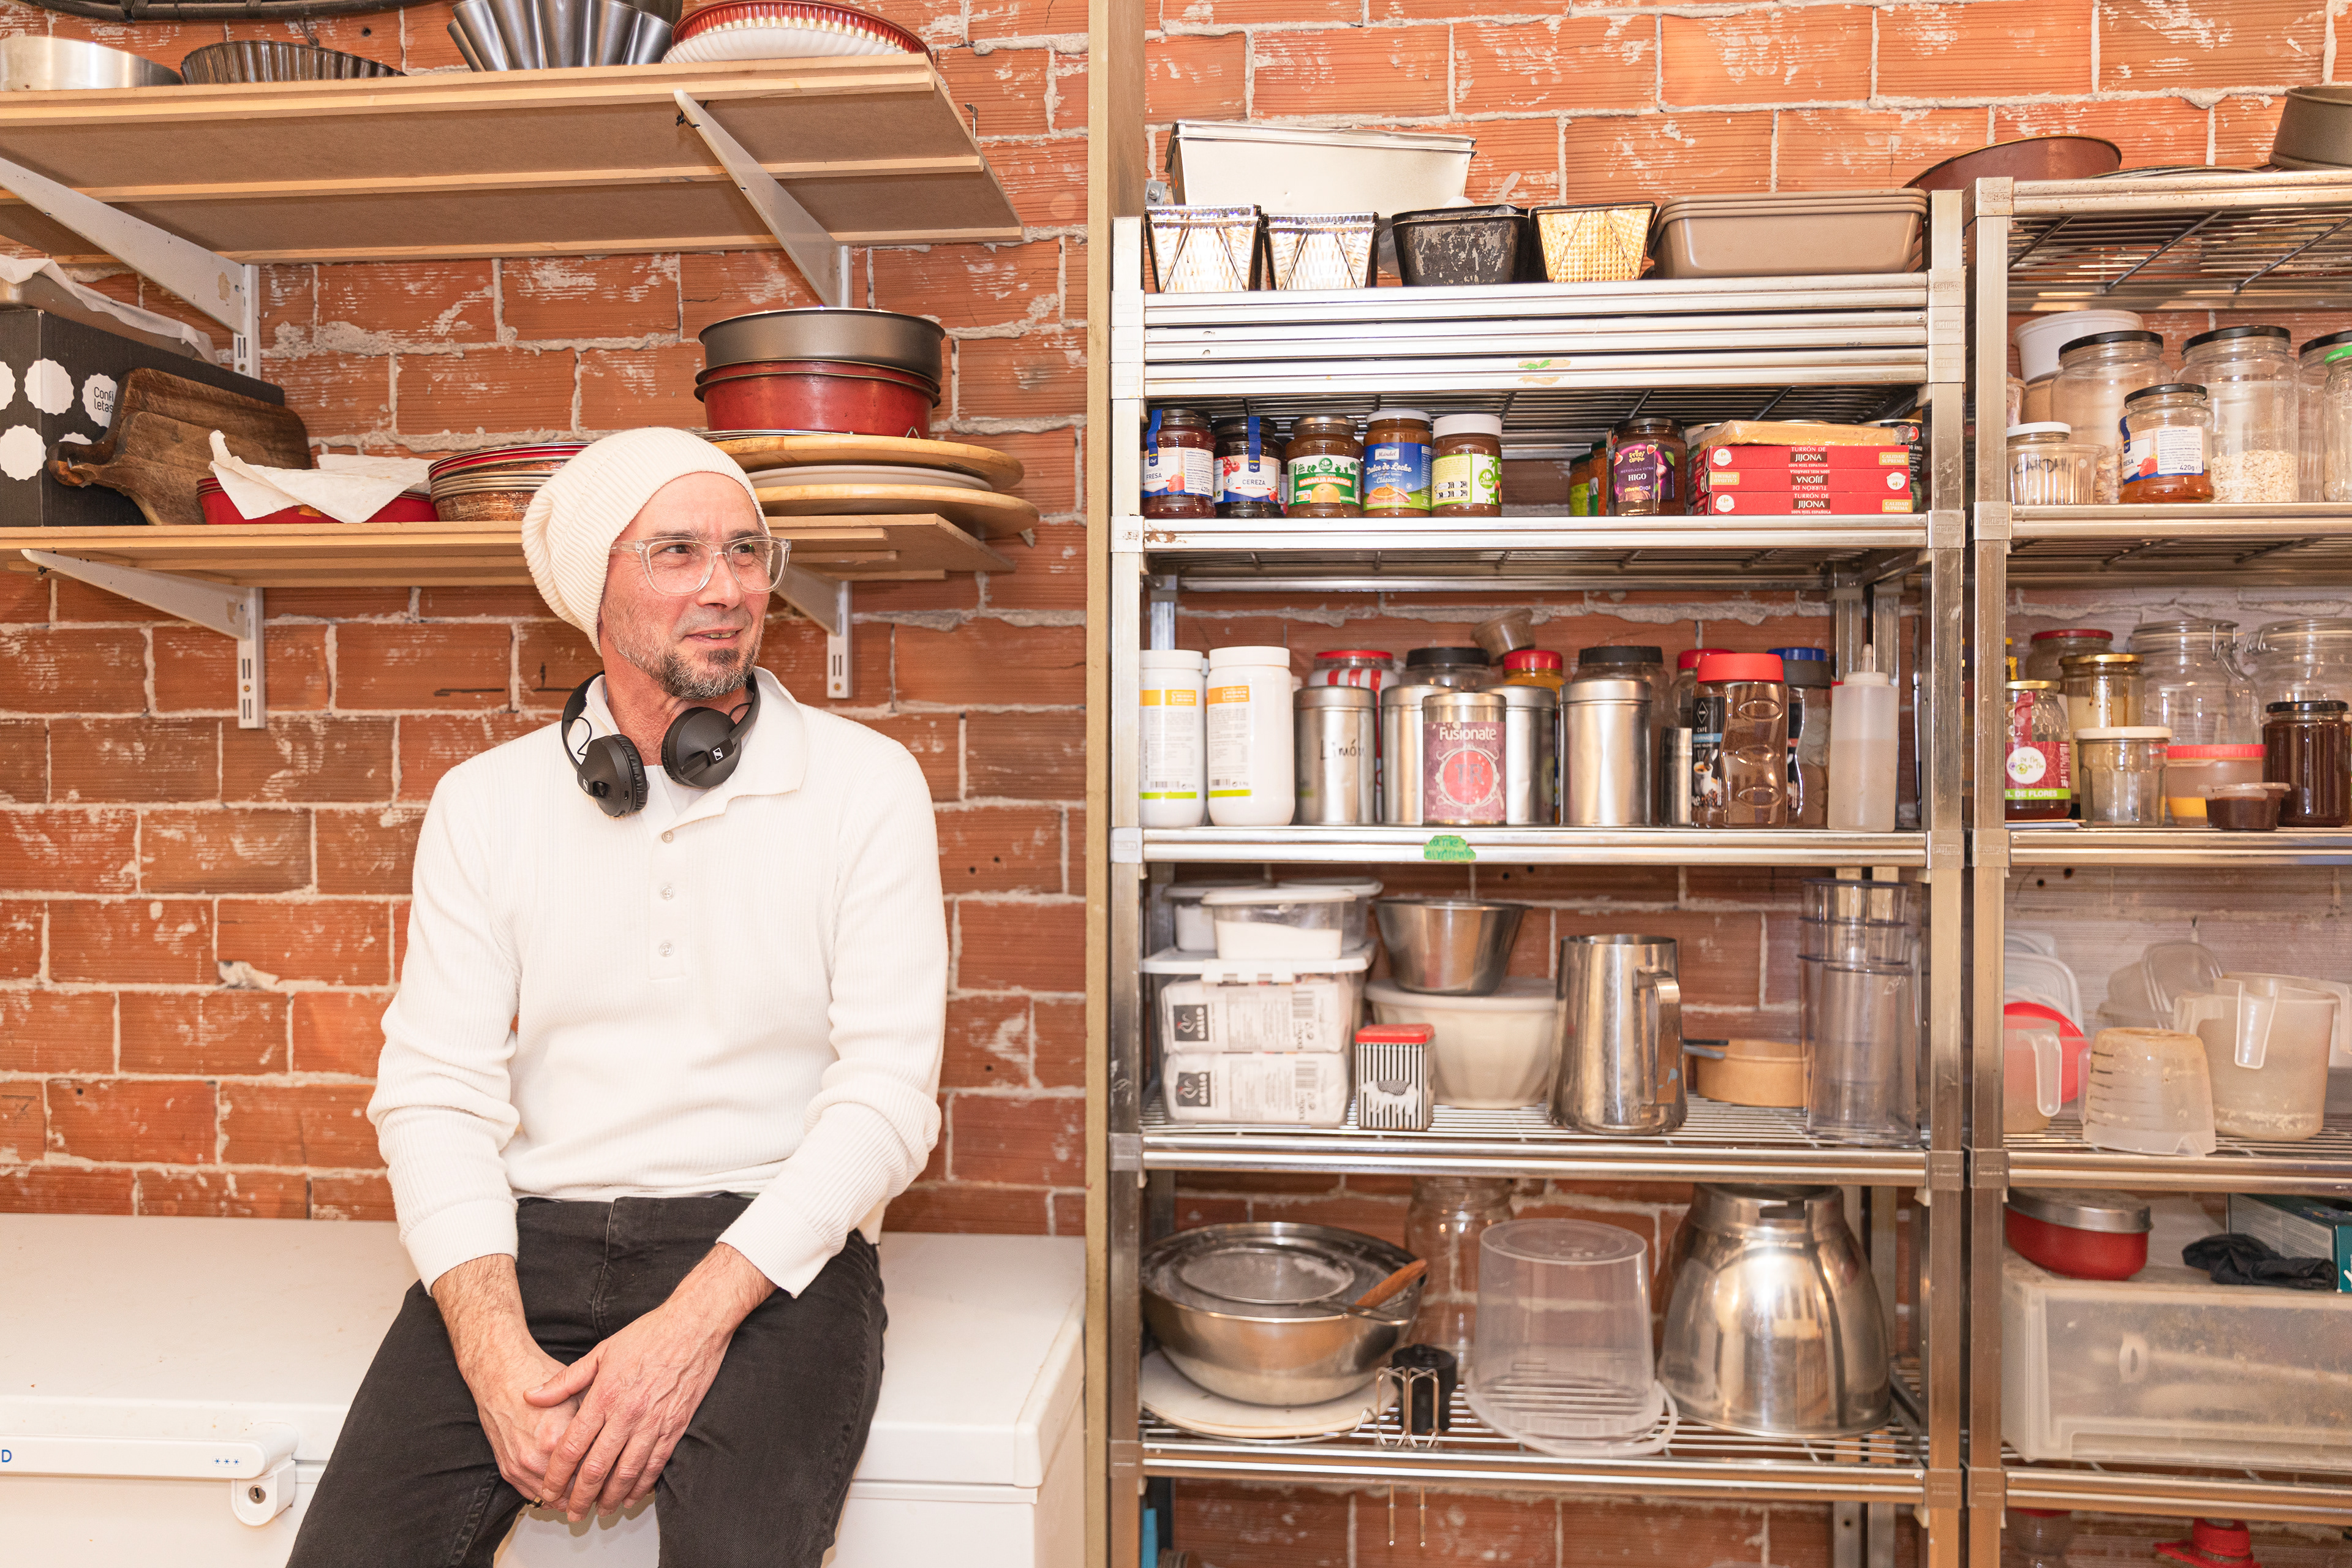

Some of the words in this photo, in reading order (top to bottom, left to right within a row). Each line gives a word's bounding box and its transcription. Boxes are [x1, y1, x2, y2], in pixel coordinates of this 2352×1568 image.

[94, 386, 114, 402] Confi
[94, 398, 114, 413] letas
[1795, 453, 1822, 462] JIJONA
[1366, 464, 1382, 475] Dulce
[1382, 462, 1390, 470] de
[1390, 462, 1412, 472] Leche
[1299, 477, 1326, 486] NARANJA
[1327, 477, 1351, 486] AMARGA
[1628, 473, 1646, 481] HIGO
[1796, 475, 1823, 484] JIJONA
[1798, 500, 1825, 509] JIJONA
[1439, 726, 1497, 741] Fusionate
